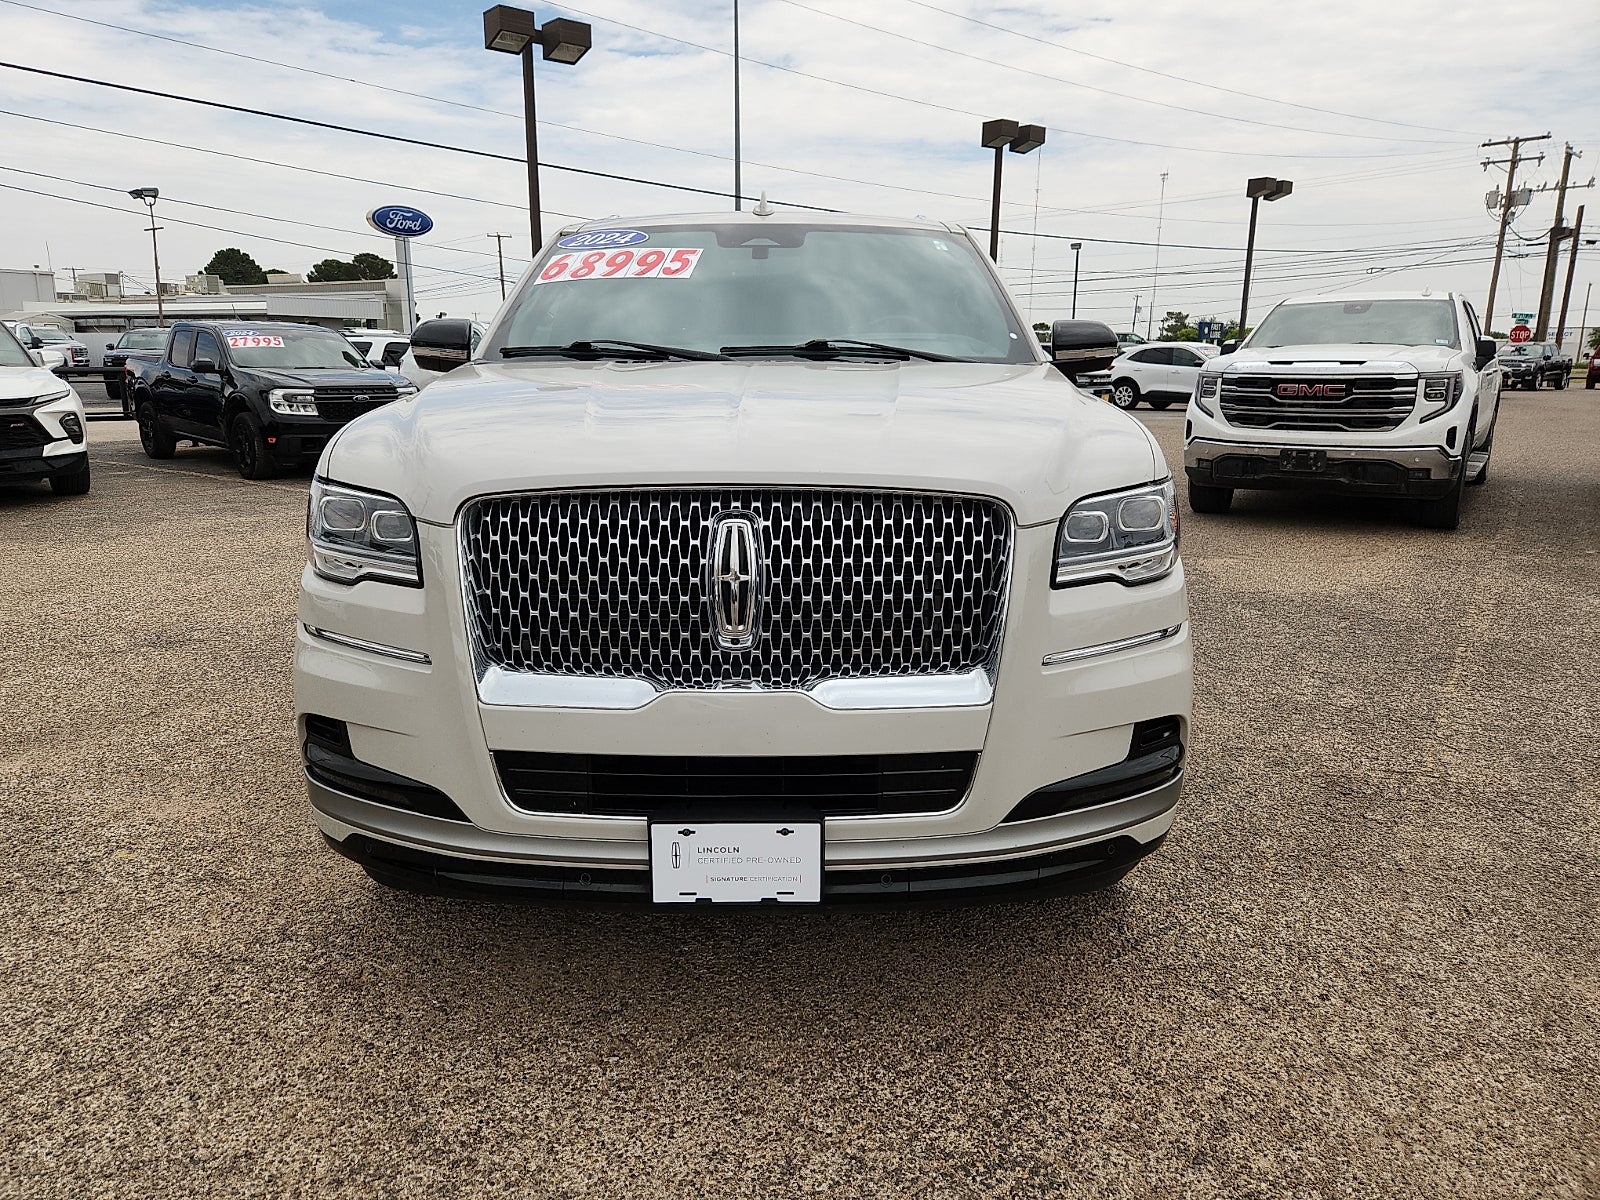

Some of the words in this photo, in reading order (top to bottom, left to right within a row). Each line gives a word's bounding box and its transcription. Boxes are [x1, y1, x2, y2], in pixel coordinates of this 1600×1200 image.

[386, 210, 421, 230] Ford
[570, 232, 637, 246] 2024
[540, 250, 699, 281] 68995
[230, 336, 281, 347] 27995
[1511, 330, 1530, 340] STOP
[1277, 383, 1346, 396] GMC
[697, 846, 740, 854] LINCOLN
